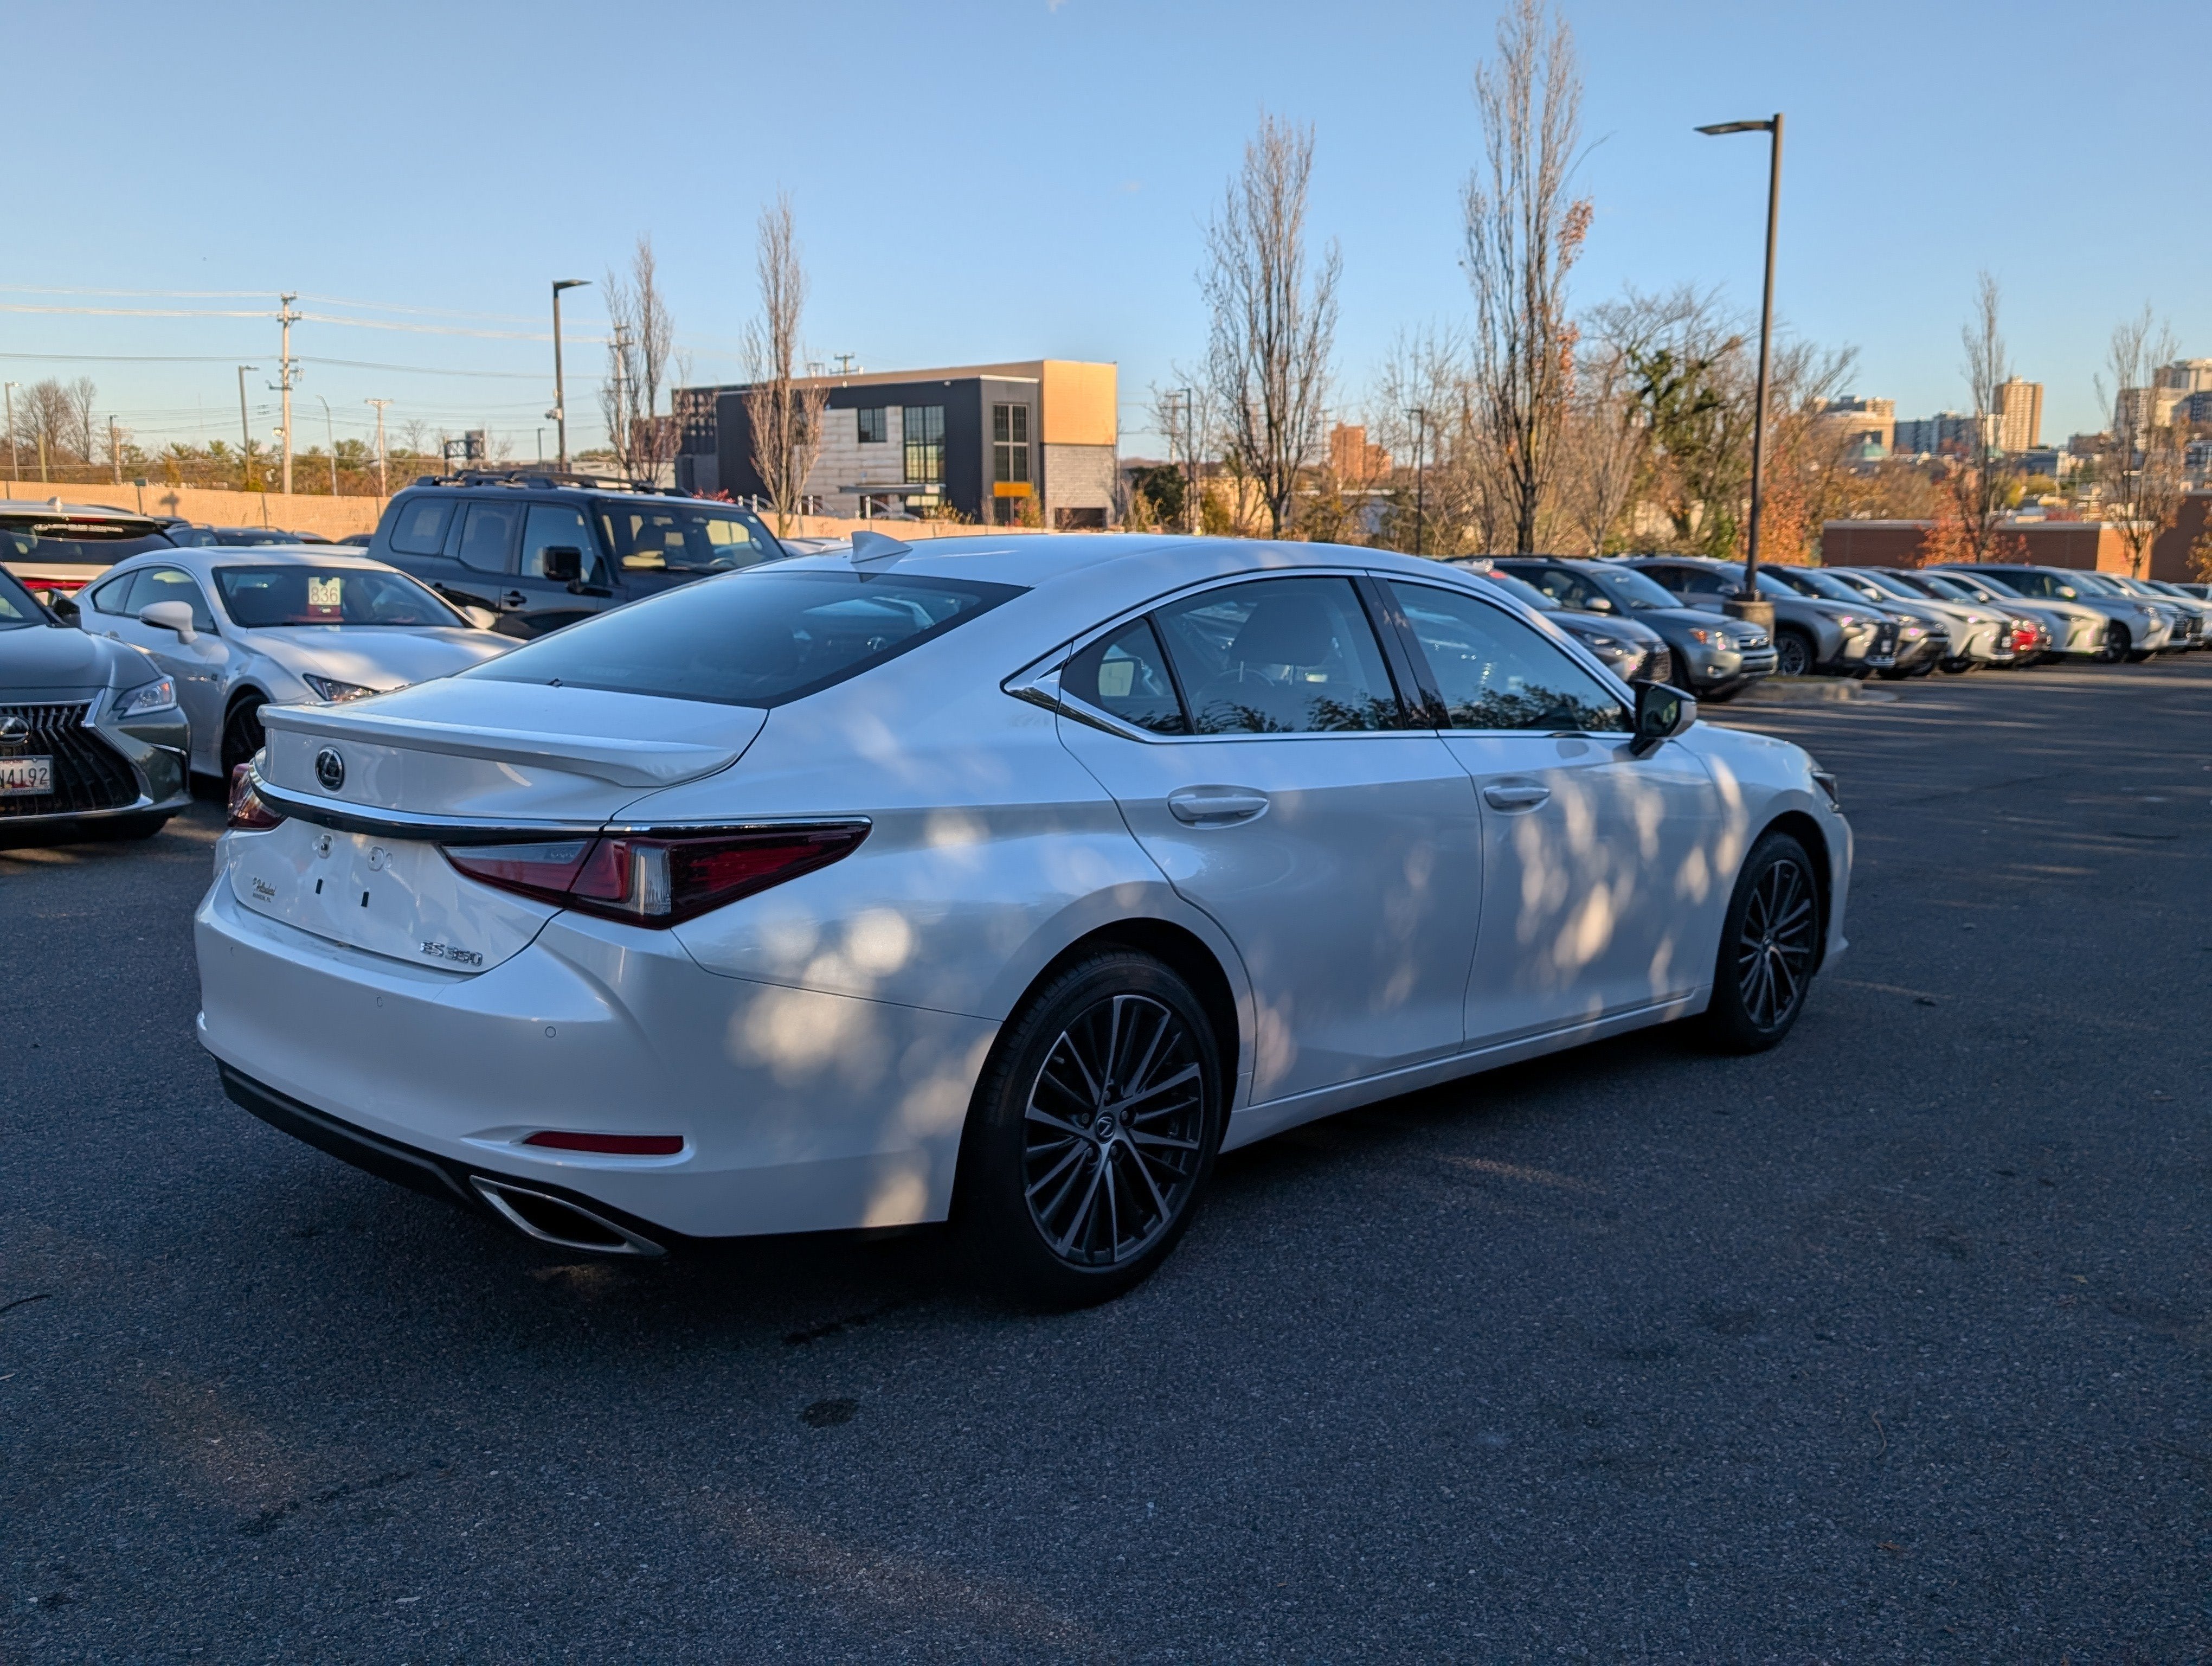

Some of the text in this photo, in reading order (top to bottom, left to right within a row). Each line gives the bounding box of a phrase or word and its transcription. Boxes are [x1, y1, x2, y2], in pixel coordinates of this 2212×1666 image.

[311, 586, 338, 603] 836
[420, 940, 483, 966] ES 350
